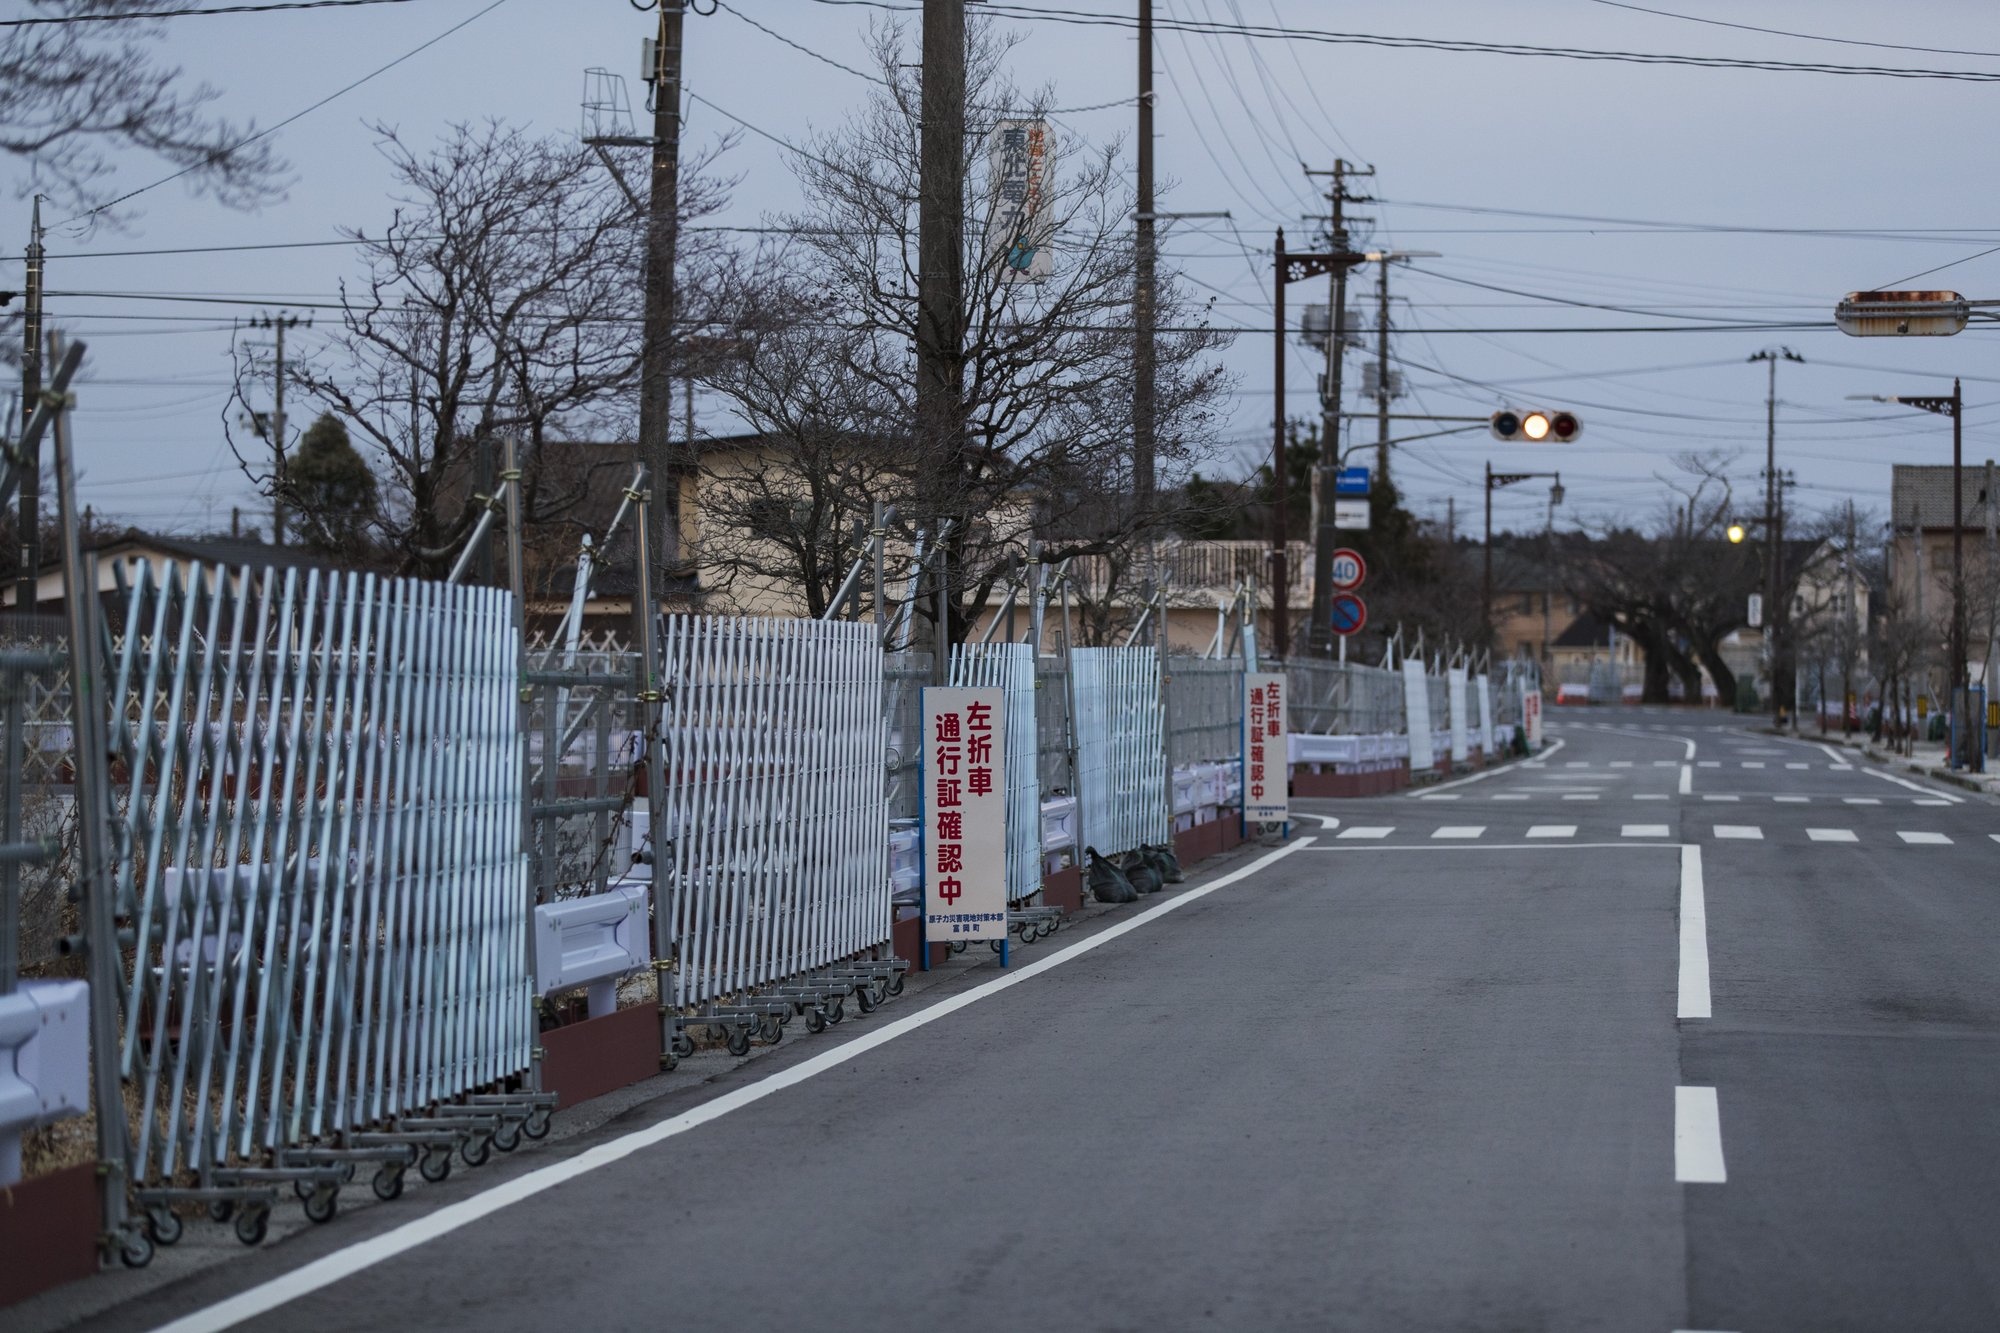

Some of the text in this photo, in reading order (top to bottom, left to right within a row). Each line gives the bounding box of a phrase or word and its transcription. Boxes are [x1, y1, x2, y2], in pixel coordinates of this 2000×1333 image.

[1331, 561, 1356, 580] 40
[1250, 688, 1265, 801] 通行証確認中
[1266, 681, 1281, 738] 左折車
[966, 701, 993, 797] 左折車
[935, 712, 963, 906] 通行証確認中
[929, 913, 1004, 923] 原子力災害現地対策本部
